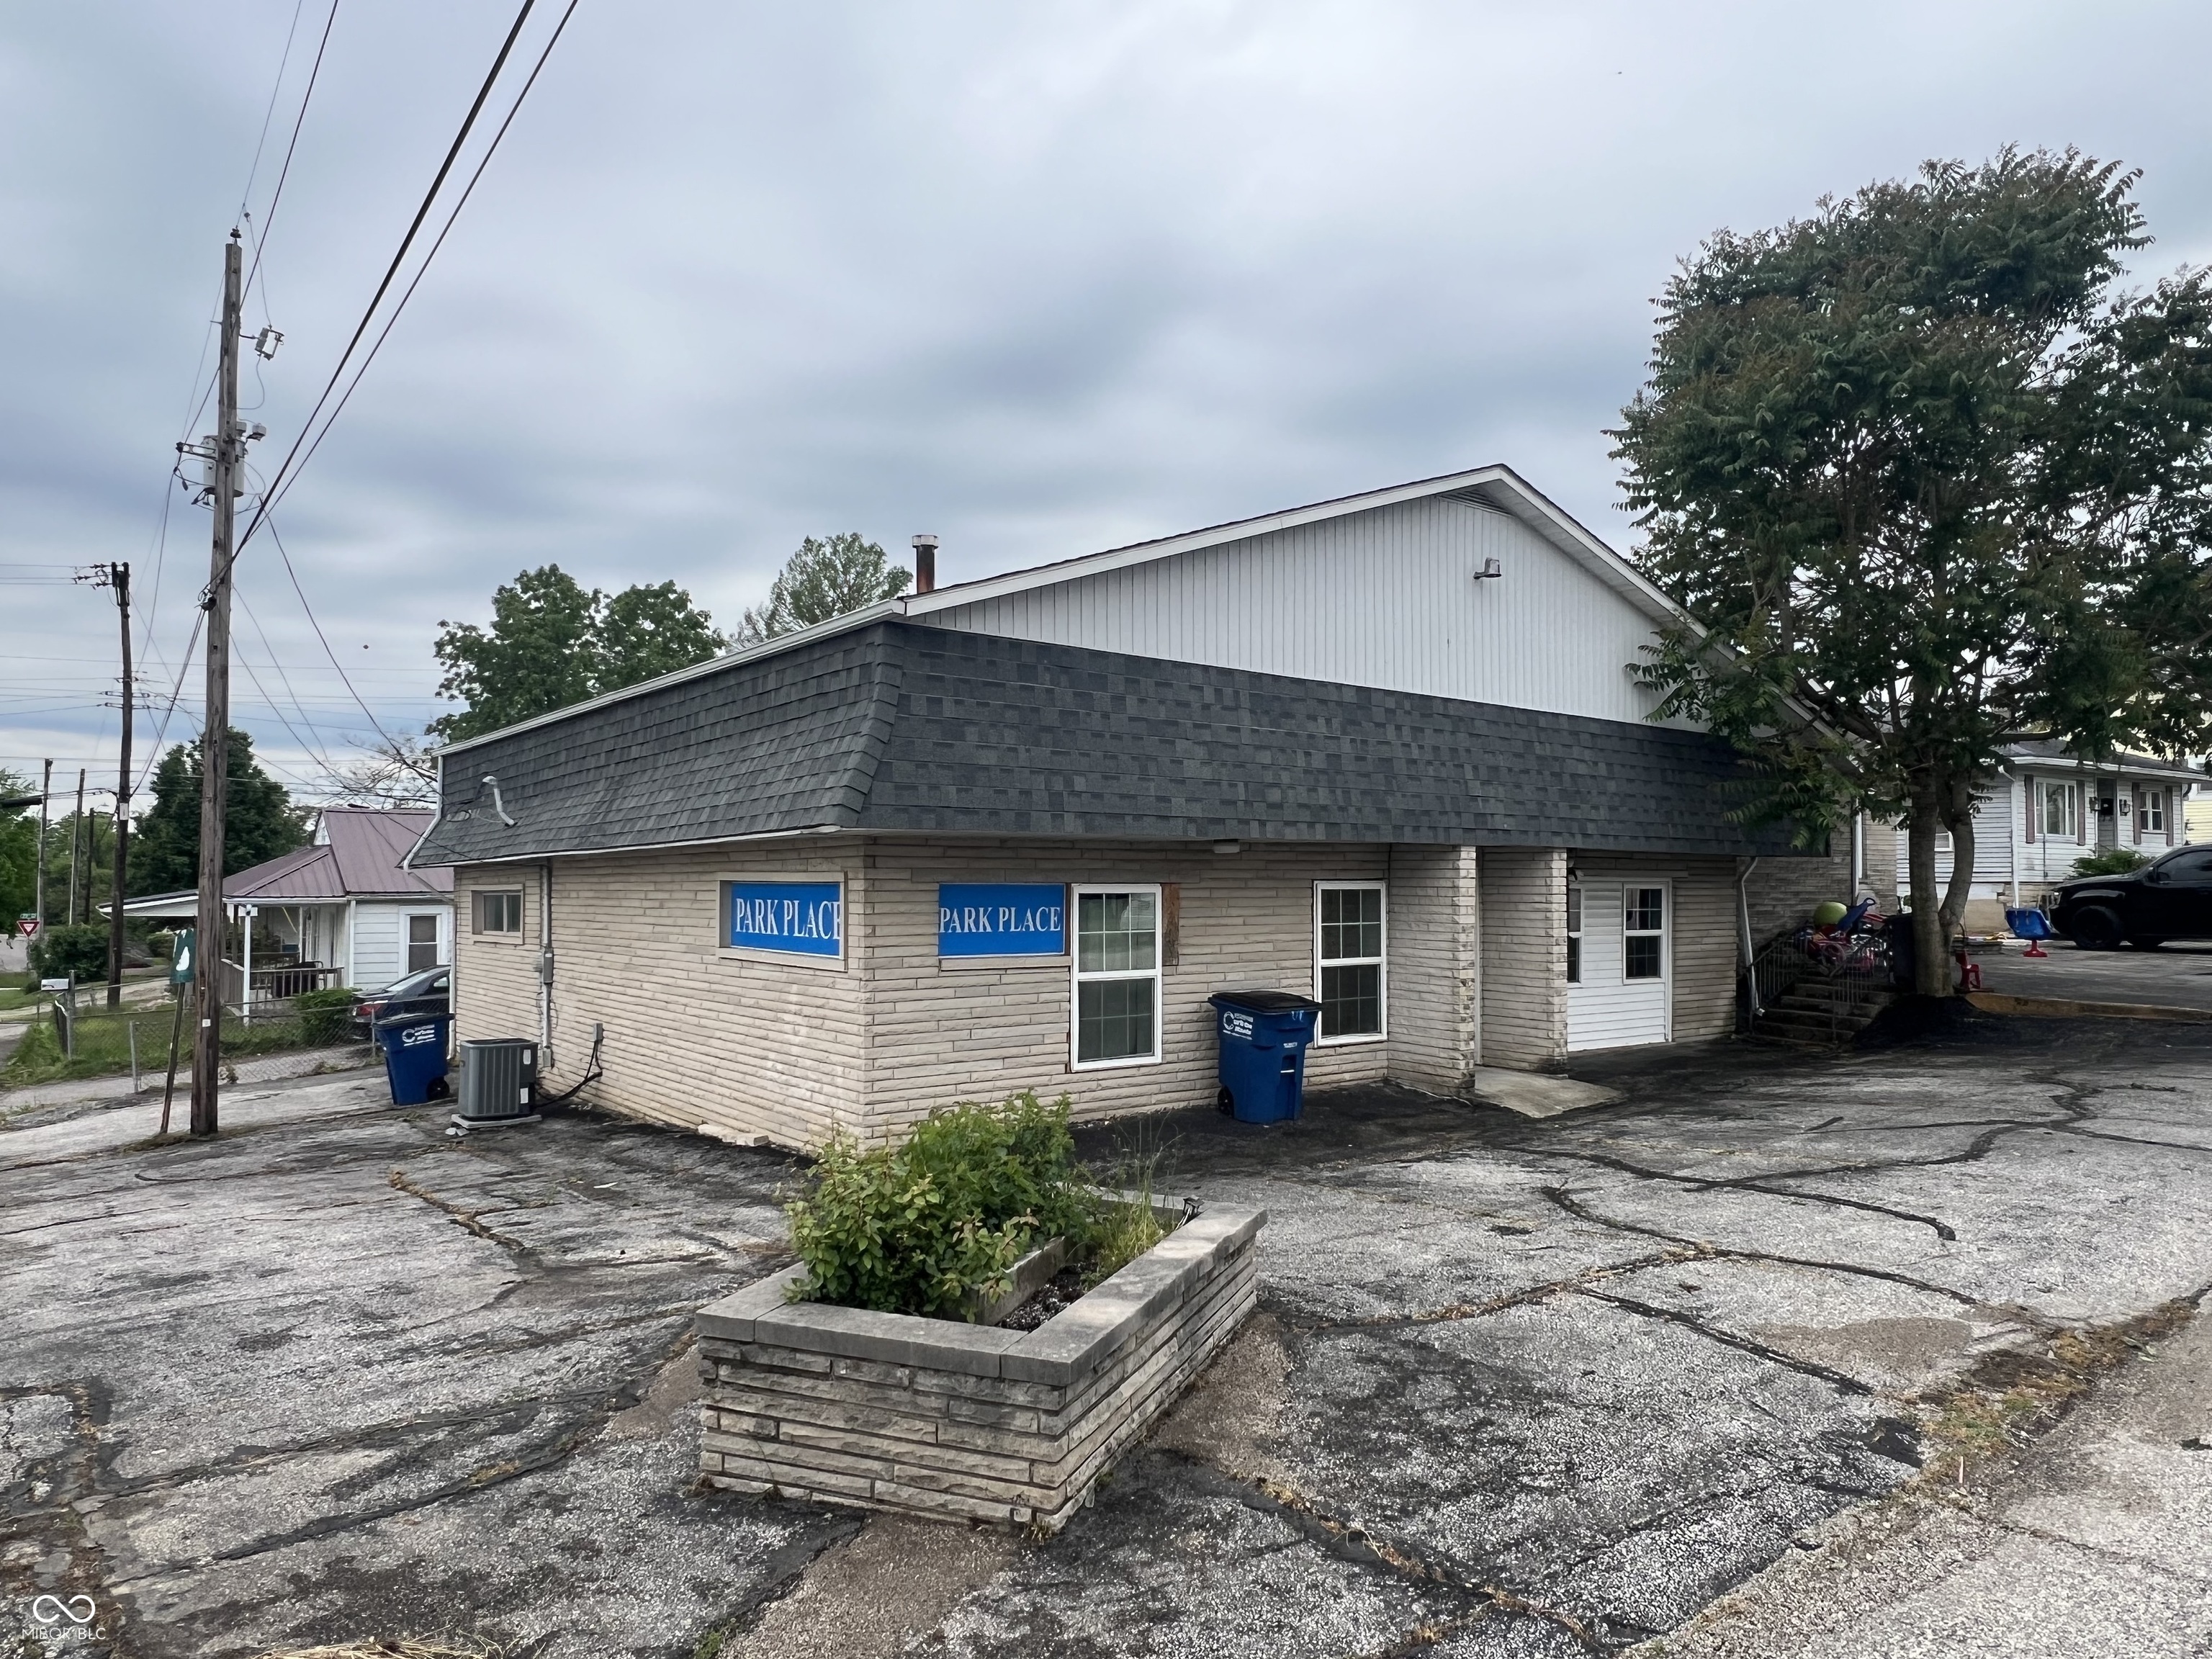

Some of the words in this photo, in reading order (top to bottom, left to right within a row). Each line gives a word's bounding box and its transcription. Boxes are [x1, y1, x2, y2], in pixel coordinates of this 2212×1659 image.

[735, 898, 778, 935] PARK
[939, 907, 992, 933] PARK
[998, 907, 1061, 932] PLACE
